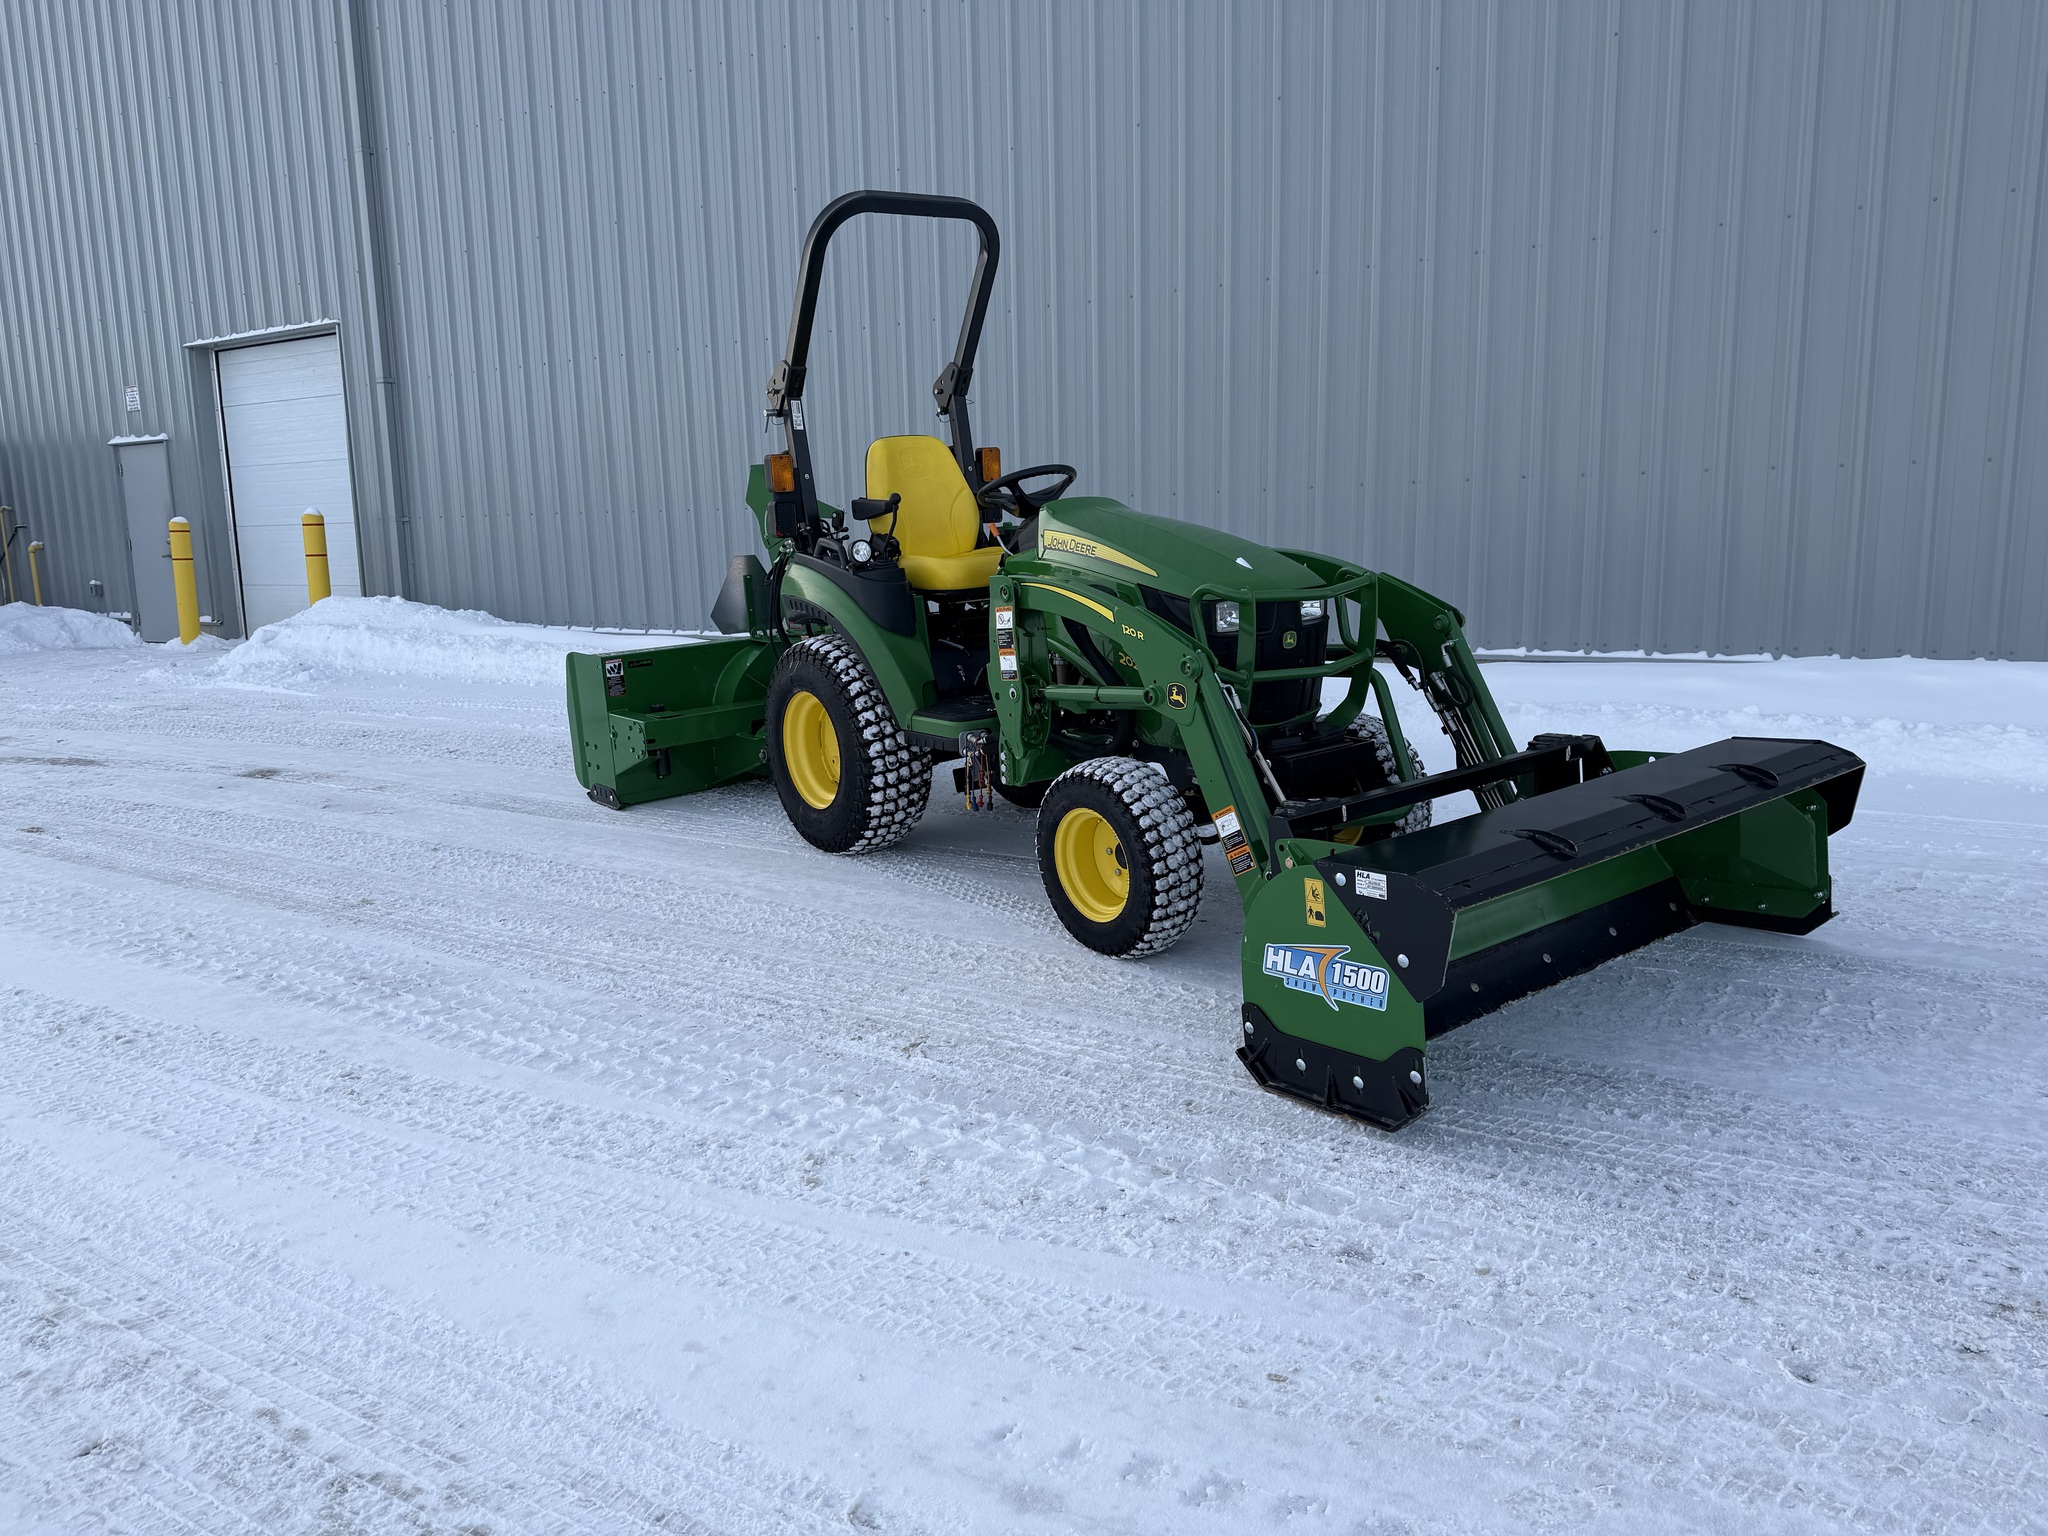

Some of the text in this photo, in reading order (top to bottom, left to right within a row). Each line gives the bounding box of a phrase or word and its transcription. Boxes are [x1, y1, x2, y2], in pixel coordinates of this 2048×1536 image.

[1047, 535, 1097, 556] JOHN DEERE
[1121, 623, 1144, 641] 120 R
[1356, 871, 1371, 880] HLA
[1266, 946, 1386, 994] HLA 1500
[1286, 977, 1384, 1009] SNOW PUSHER
